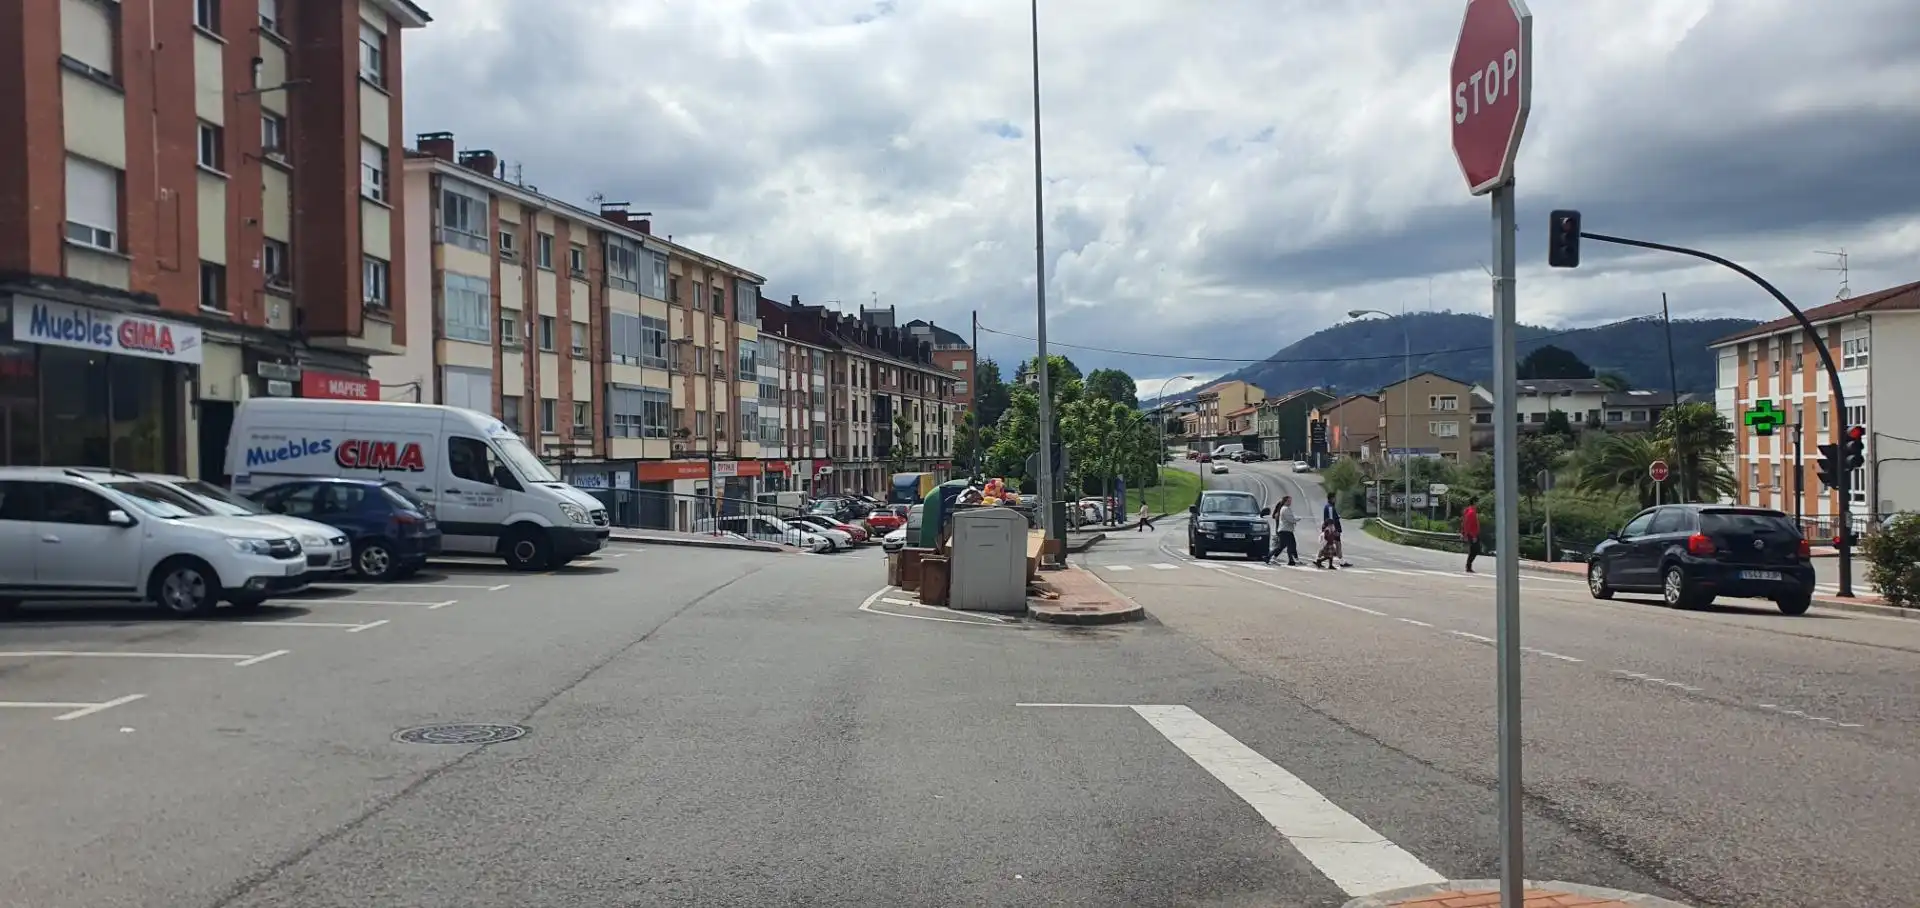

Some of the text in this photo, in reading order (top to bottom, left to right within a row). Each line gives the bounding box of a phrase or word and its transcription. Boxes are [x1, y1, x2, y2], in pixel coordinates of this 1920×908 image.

[1455, 48, 1517, 124] STOP
[30, 302, 176, 355] Muebles CIMA
[328, 379, 367, 397] MAPFRE
[246, 437, 425, 472] Muebles CIMA
